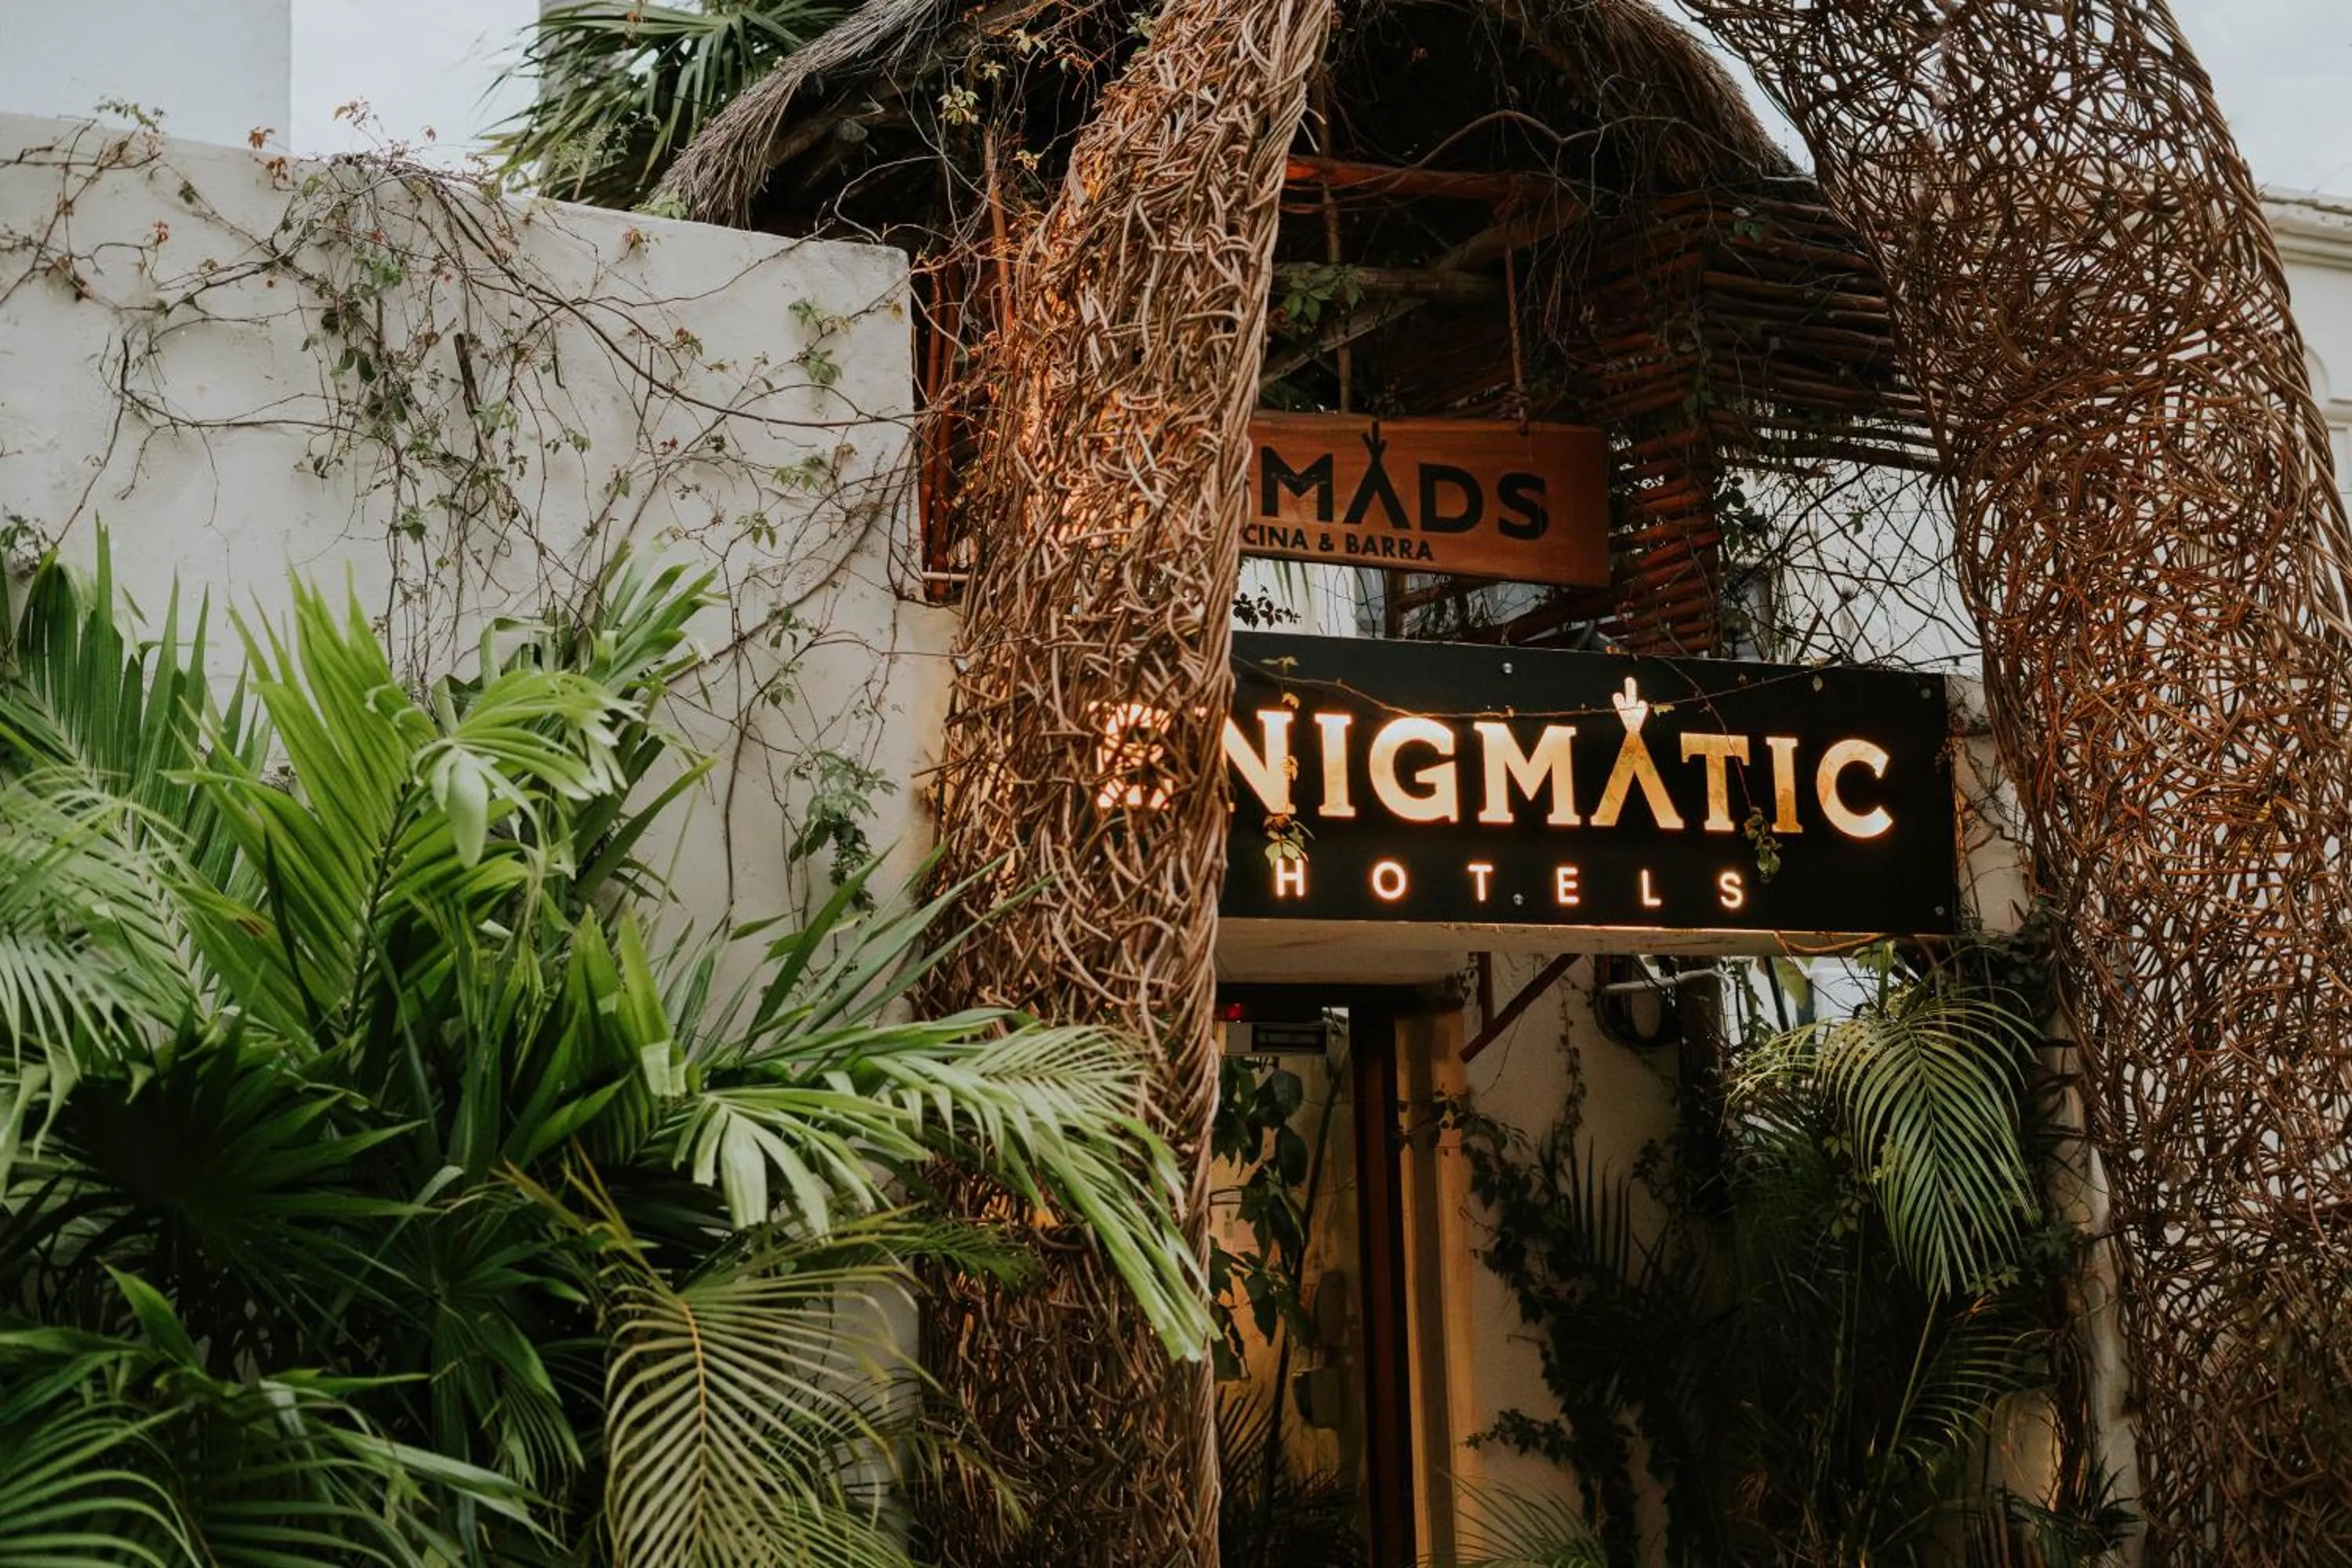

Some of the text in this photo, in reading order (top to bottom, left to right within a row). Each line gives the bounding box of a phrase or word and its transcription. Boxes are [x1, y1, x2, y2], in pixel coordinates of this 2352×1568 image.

[1247, 421, 1551, 541] MADS
[1240, 524, 1435, 561] CINA & BARRA
[1276, 858, 1744, 909] HOTELS
